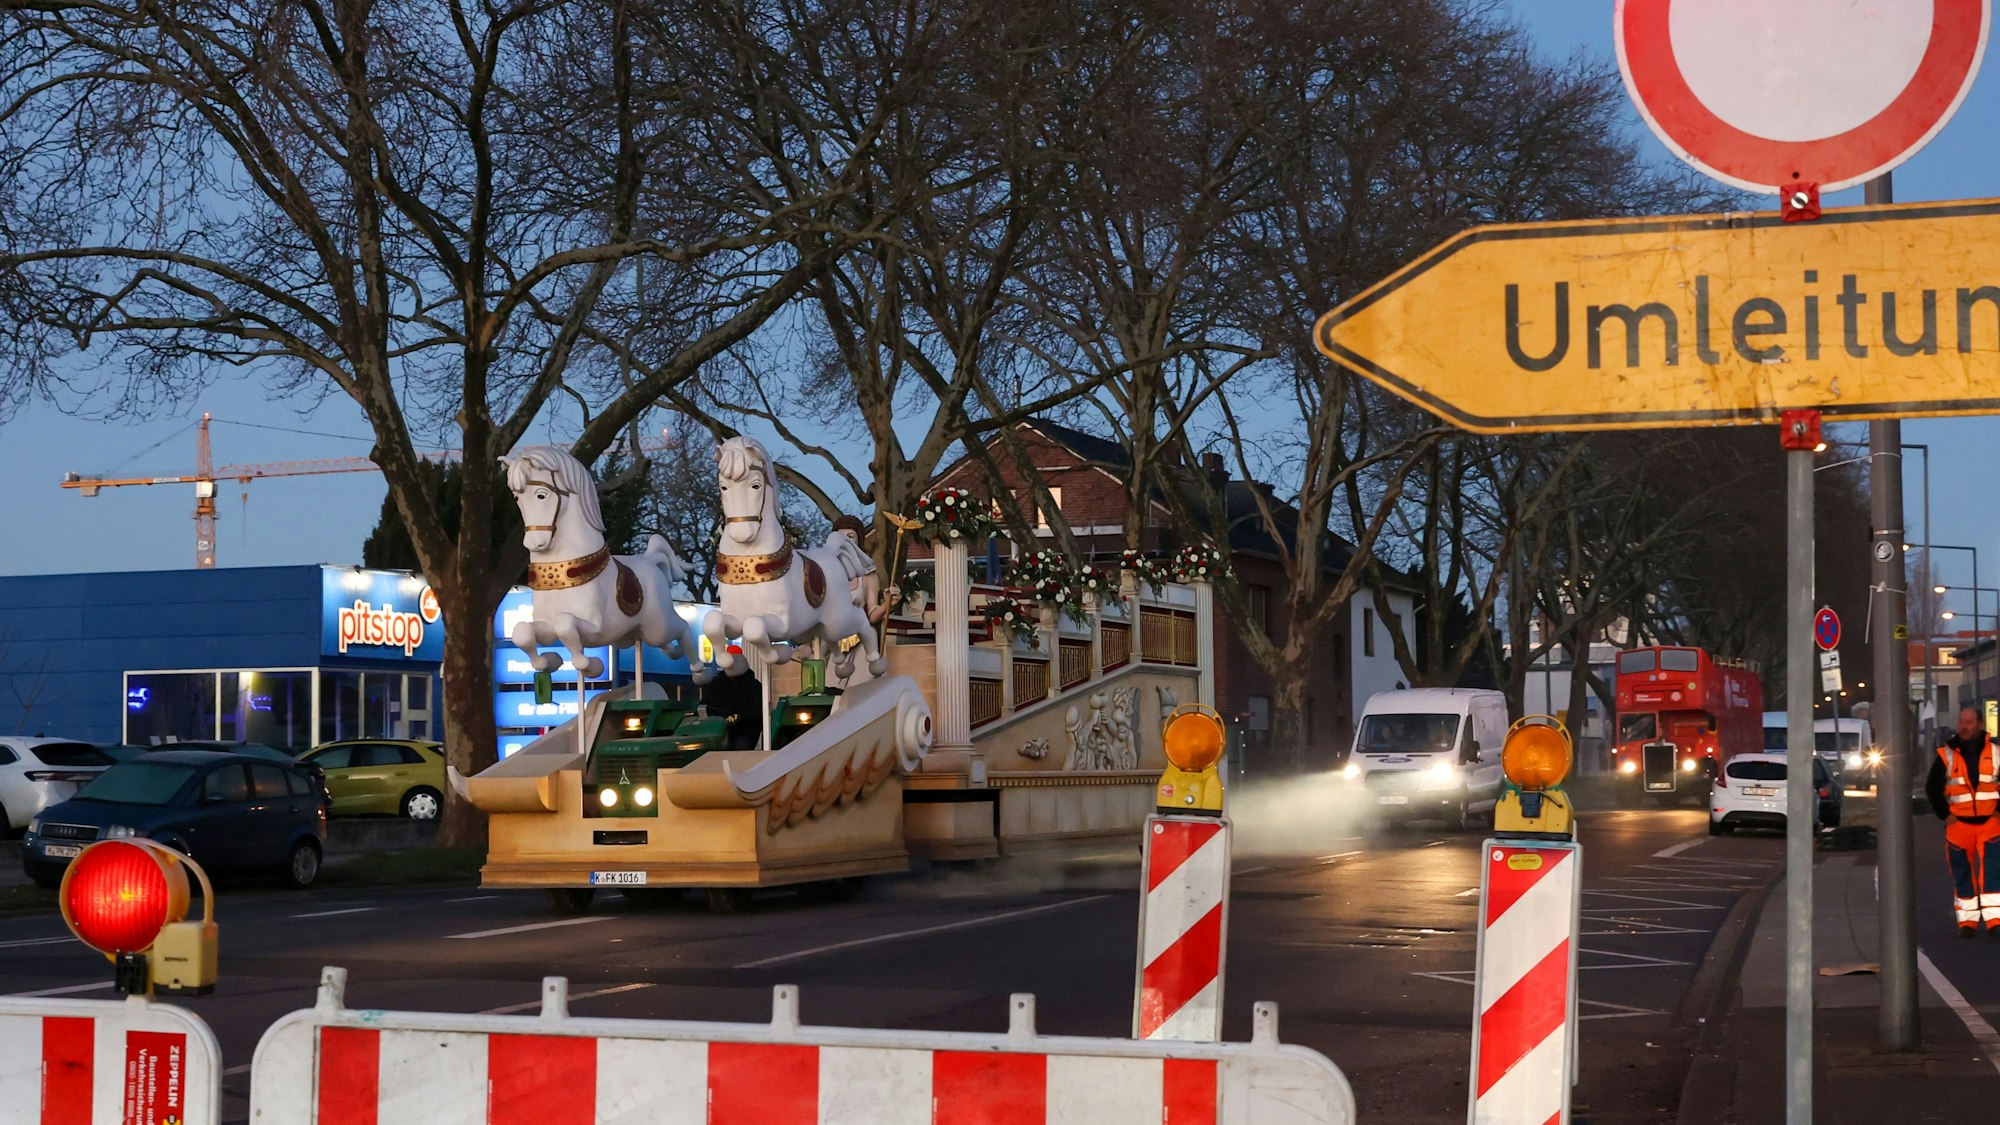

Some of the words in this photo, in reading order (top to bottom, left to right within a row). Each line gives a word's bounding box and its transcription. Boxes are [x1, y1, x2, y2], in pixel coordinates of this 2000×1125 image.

[339, 599, 423, 656] pitstop
[605, 873, 616, 883] FK
[618, 873, 639, 883] 1016
[168, 1045, 180, 1108] ZEPPELIN
